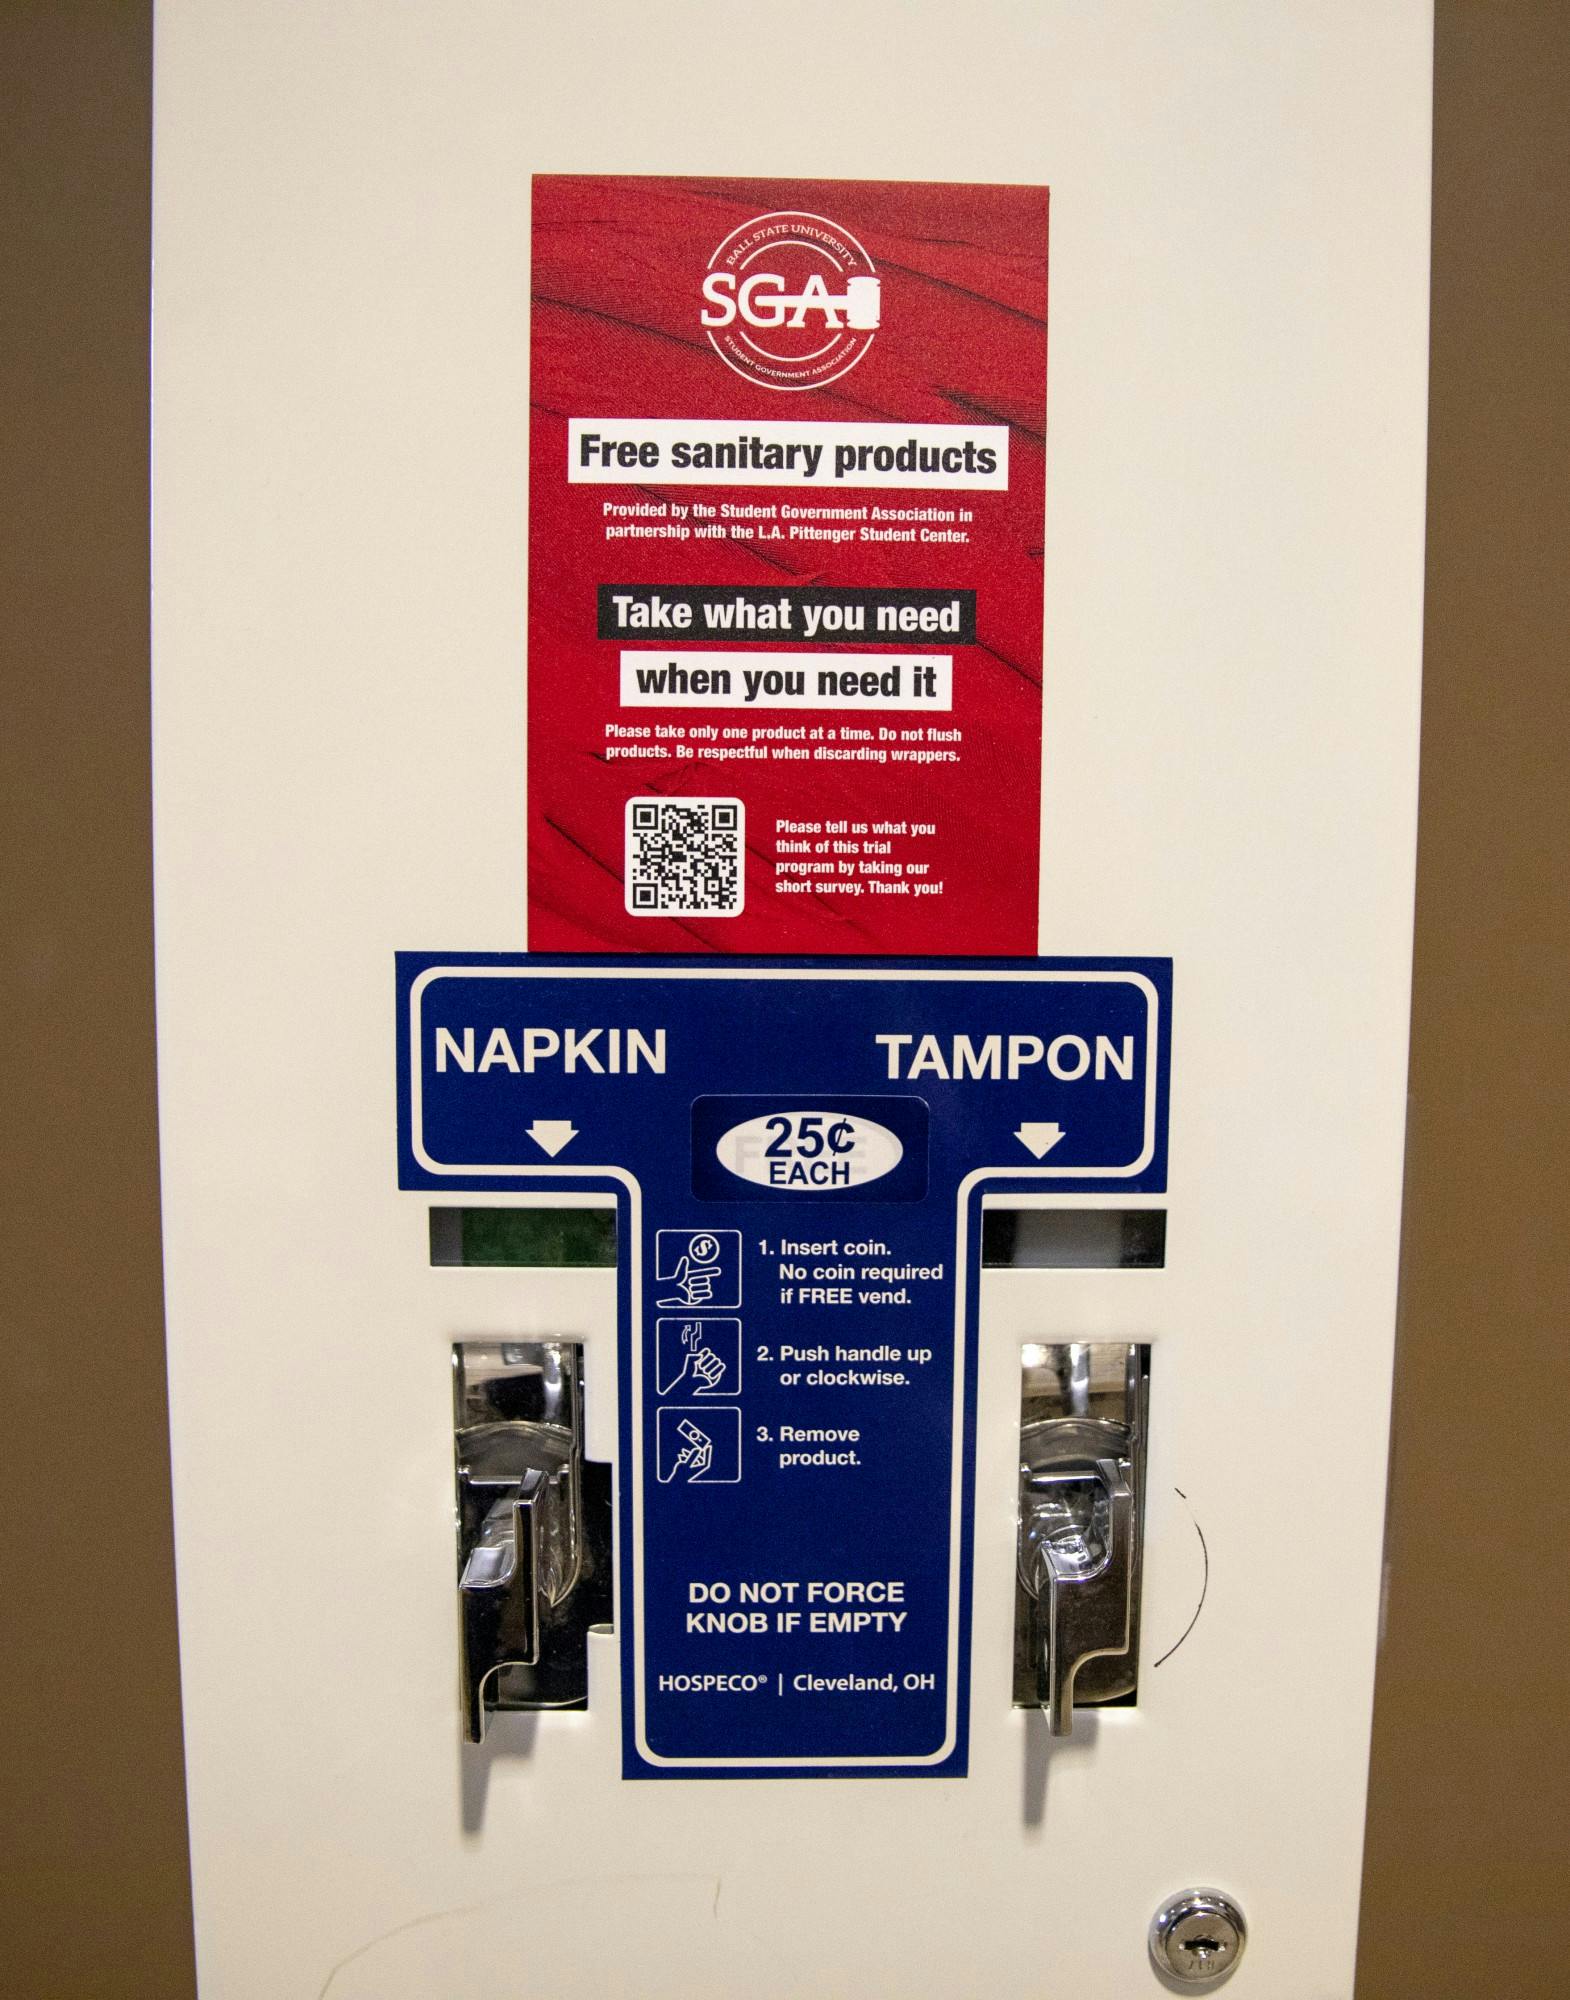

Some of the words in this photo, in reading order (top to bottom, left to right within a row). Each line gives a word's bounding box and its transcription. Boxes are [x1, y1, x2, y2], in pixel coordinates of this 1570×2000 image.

[726, 240, 754, 266] BALL
[753, 224, 789, 242] STATE
[791, 224, 857, 267] UNIVERSITY
[701, 272, 844, 328] SGA
[724, 336, 754, 366] STUDENT
[755, 364, 810, 378] GOVERNMENT
[812, 338, 857, 375] ASSOCIATION
[580, 433, 660, 468] Free
[671, 435, 824, 478] sanitary
[834, 439, 997, 479] products
[603, 502, 667, 520] Provided
[671, 503, 689, 521] by
[692, 503, 717, 518] the
[720, 503, 777, 519] Student
[780, 504, 868, 520] Government
[870, 506, 952, 522] Association
[959, 508, 973, 522] in
[605, 523, 691, 541] partnership
[694, 524, 727, 539] with
[730, 525, 754, 540] the
[758, 525, 786, 540] L.A.
[789, 525, 857, 544] Pittenger
[859, 526, 917, 542] Student
[920, 527, 970, 543] Center.
[612, 595, 693, 629] Take
[703, 597, 792, 630] what
[802, 605, 865, 637] you
[876, 600, 960, 633] need
[635, 662, 731, 695] when
[742, 670, 805, 702] you
[817, 665, 901, 697] need
[913, 665, 937, 698] it
[605, 723, 651, 738] Please
[654, 724, 686, 738] take
[688, 725, 719, 741] only
[722, 727, 748, 739] one
[751, 725, 807, 742] product
[809, 726, 824, 740] at
[827, 729, 836, 740] a
[839, 726, 875, 741] time.
[878, 727, 897, 741] Do
[900, 728, 924, 742] not
[926, 727, 962, 742] flush
[605, 744, 672, 761] products.
[676, 744, 694, 759] Be
[697, 745, 768, 762] respectful
[771, 746, 810, 760] when
[813, 746, 887, 764] discarding
[890, 750, 961, 764] wrappers.
[775, 819, 822, 834] Please
[825, 820, 848, 834] tell
[851, 823, 869, 834] us
[871, 821, 908, 835] what
[910, 823, 936, 838] you
[775, 839, 812, 853] think
[815, 839, 830, 854] of
[832, 840, 860, 854] this
[862, 840, 891, 855] trial
[775, 862, 835, 876] program
[838, 860, 856, 877] by
[858, 860, 903, 877] taking
[906, 863, 930, 875] our
[775, 879, 812, 893] short
[815, 882, 865, 897] survey.
[867, 880, 910, 894] Thank
[913, 881, 944, 897] you!
[435, 1027, 666, 1074] NAPKIN
[875, 1034, 1134, 1081] TAMPON
[764, 1116, 856, 1158] 25¢
[769, 1160, 850, 1186] EACH
[758, 1239, 775, 1255] 1.
[781, 1238, 839, 1256] Insert
[843, 1239, 892, 1256] coin.
[779, 1263, 808, 1280] No
[812, 1263, 855, 1280] coin
[861, 1263, 944, 1284] required
[780, 1287, 794, 1304] if
[799, 1287, 853, 1304] FREE
[858, 1287, 912, 1305] vend.
[756, 1345, 774, 1362] 2.
[780, 1345, 830, 1362] Push
[835, 1345, 902, 1362] handle
[907, 1348, 932, 1365] up
[779, 1373, 802, 1386] or
[806, 1369, 910, 1386] clockwise.
[756, 1426, 774, 1442] 3.
[780, 1425, 860, 1442] Remove
[779, 1449, 861, 1469] product.
[689, 1582, 731, 1604] DO
[740, 1582, 800, 1604] NOT
[807, 1581, 905, 1603] FORCE
[686, 1612, 768, 1634] KNOB
[777, 1612, 802, 1633] IF
[809, 1611, 908, 1633] EMPTY
[793, 1673, 898, 1693] Cleveland,
[903, 1673, 935, 1691] OH
